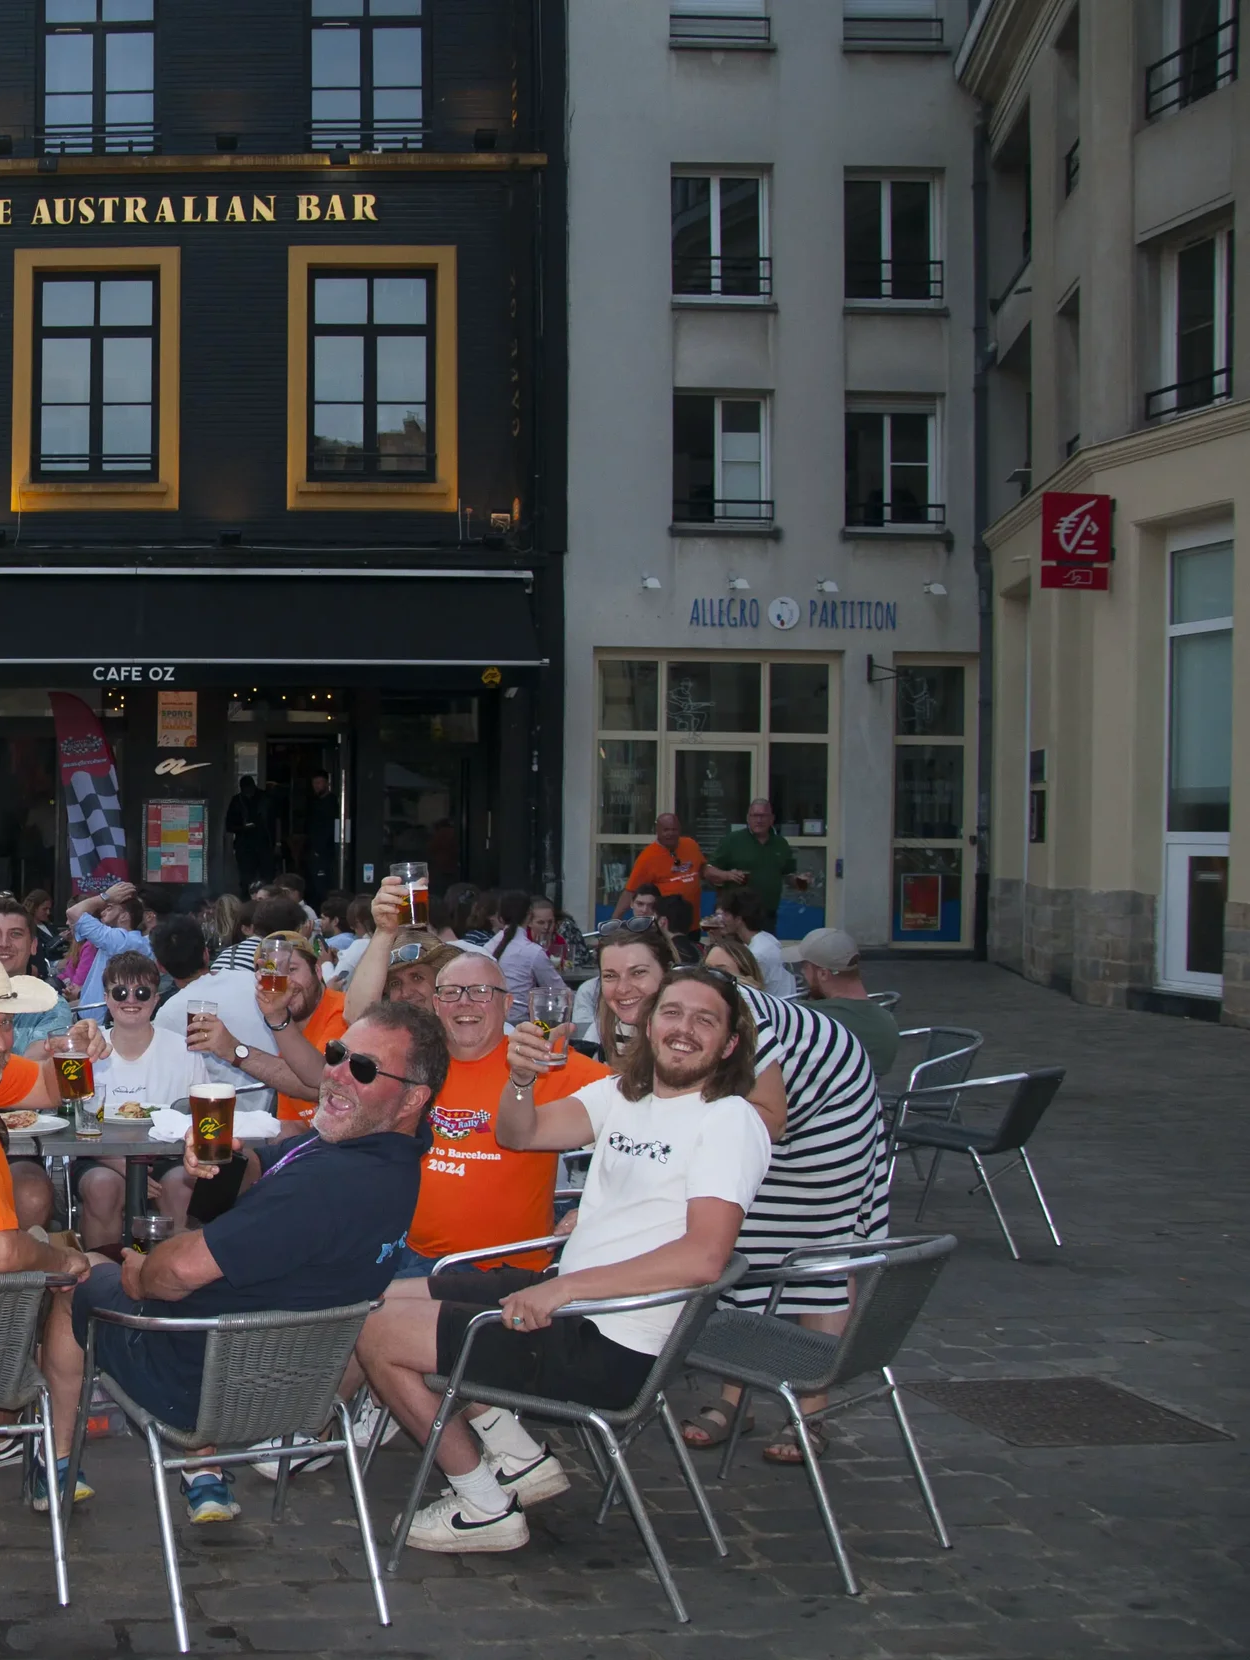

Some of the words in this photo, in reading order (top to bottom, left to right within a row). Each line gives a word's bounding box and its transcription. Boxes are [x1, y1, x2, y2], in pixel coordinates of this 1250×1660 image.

[31, 195, 277, 225] AUSTRALIAN
[296, 194, 379, 221] BAR
[690, 598, 760, 628] ALLEGRO
[809, 600, 897, 630] PARTITION
[92, 666, 142, 681] CAFE
[148, 666, 175, 681] OZ
[458, 1119, 479, 1129] Rally
[435, 1147, 445, 1155] to
[448, 1148, 501, 1160] Barcelona
[427, 1159, 465, 1176] 2024
